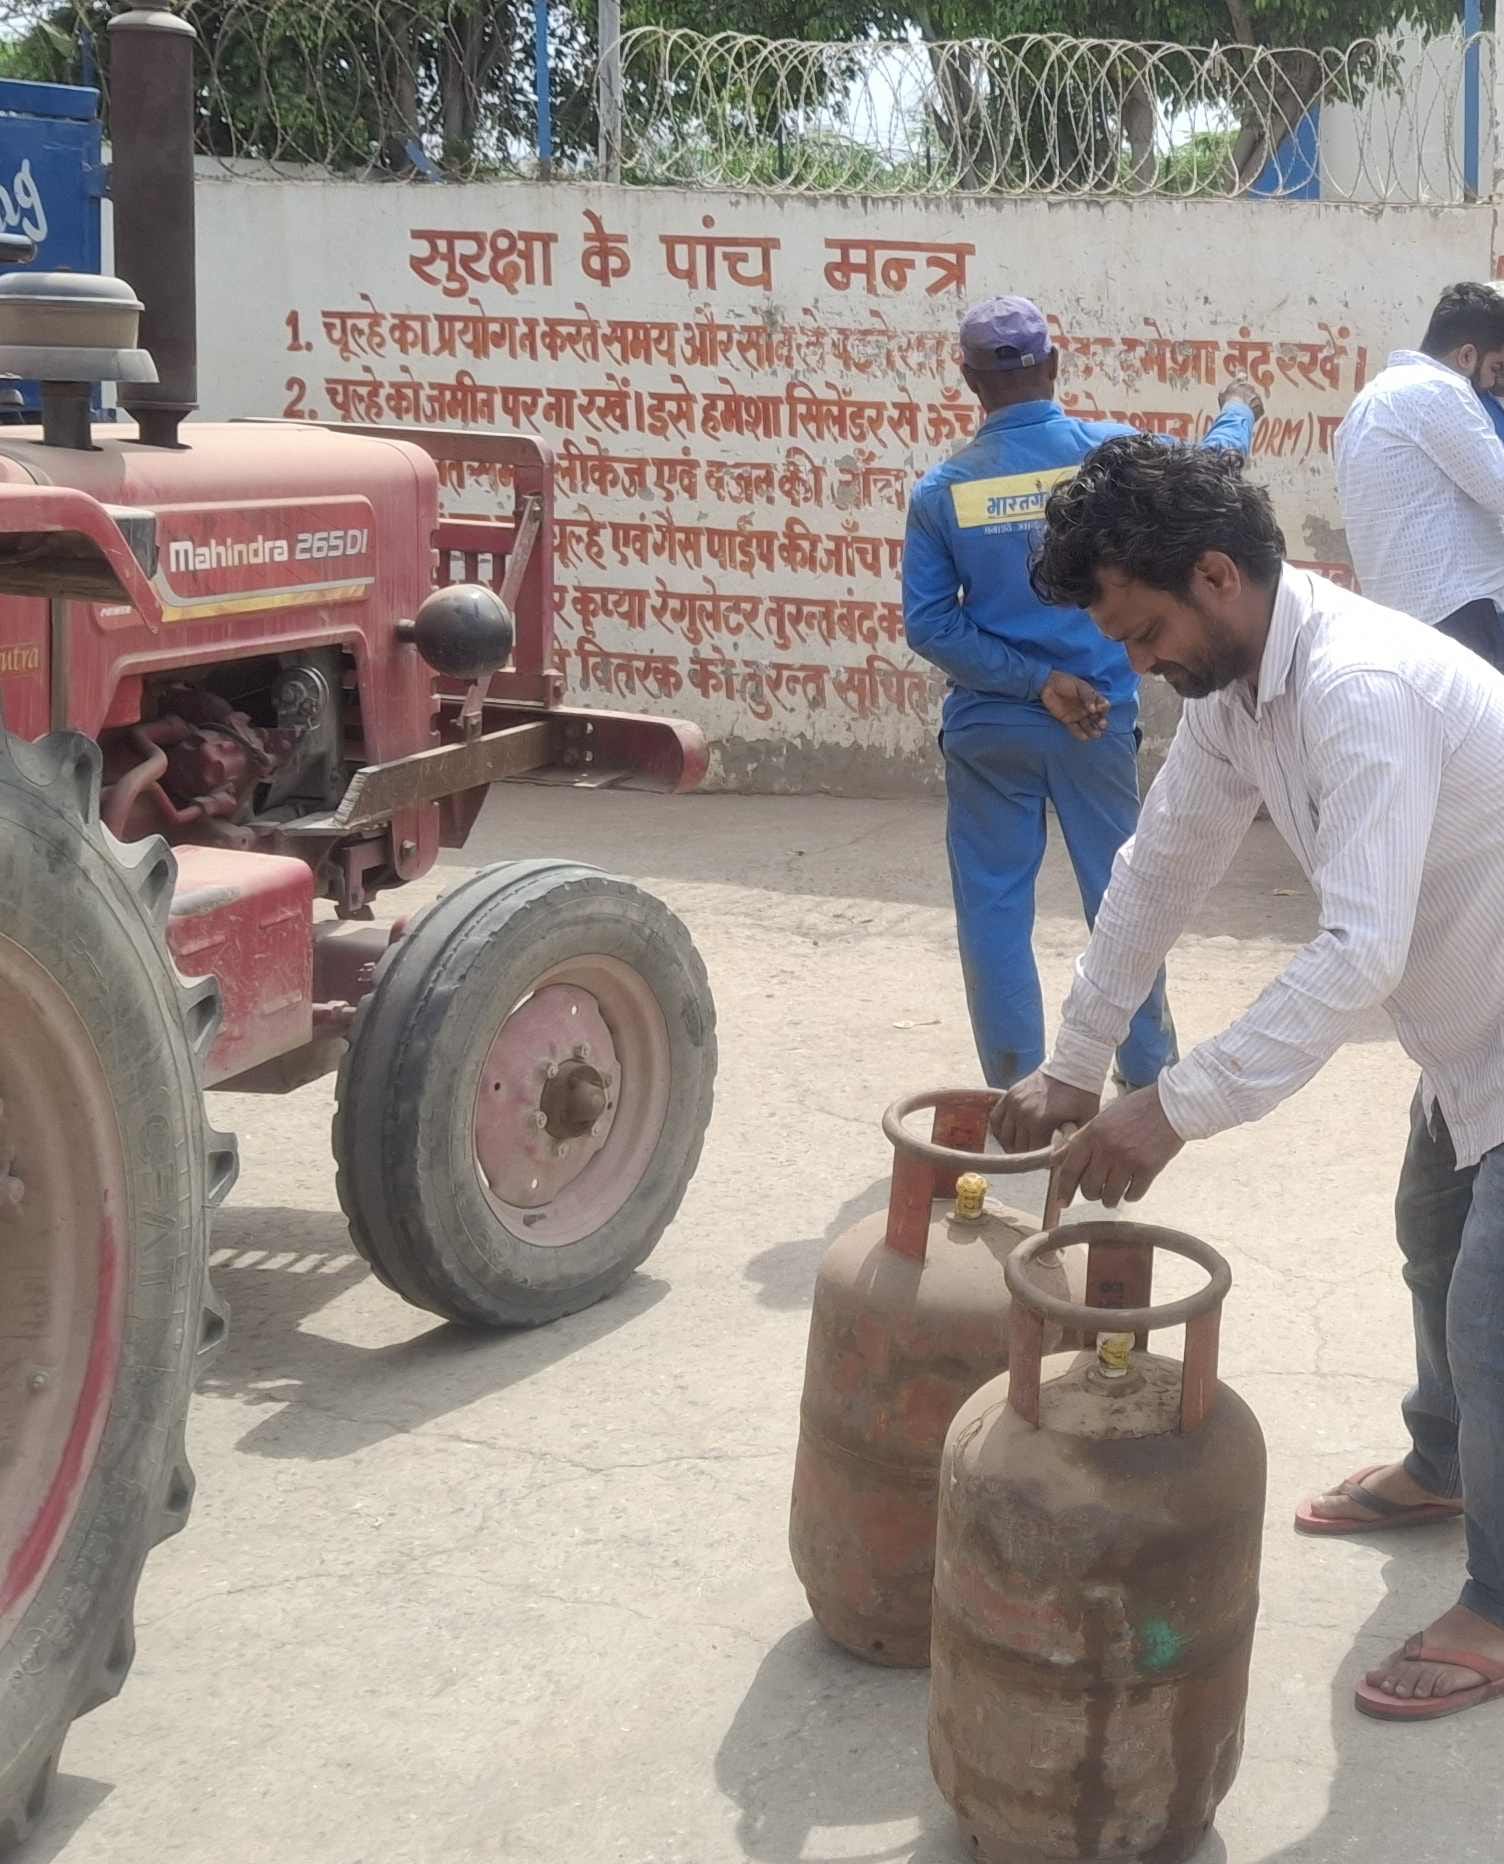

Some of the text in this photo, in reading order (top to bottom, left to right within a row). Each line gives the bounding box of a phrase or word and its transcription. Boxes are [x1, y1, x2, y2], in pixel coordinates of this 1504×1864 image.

[409, 208, 976, 298] सुरक्षा के पांच मन्त्र
[285, 310, 314, 352] 1.
[321, 292, 387, 362] चूल्हे
[387, 312, 432, 356] का
[432, 296, 520, 361] प्रयोग
[540, 301, 600, 364] करते
[600, 319, 678, 367] समय
[324, 363, 385, 424] चूल्हे
[385, 363, 425, 423] को
[424, 369, 499, 426] जमीन
[500, 386, 542, 434] पर
[542, 387, 577, 431] ना
[646, 374, 698, 441] इसे
[701, 376, 784, 443] हमेशा
[887, 384, 922, 450] से
[168, 533, 290, 574] Mahindra
[653, 506, 708, 570] गैस
[779, 516, 823, 574] की
[650, 576, 764, 646] रेगुलेटर
